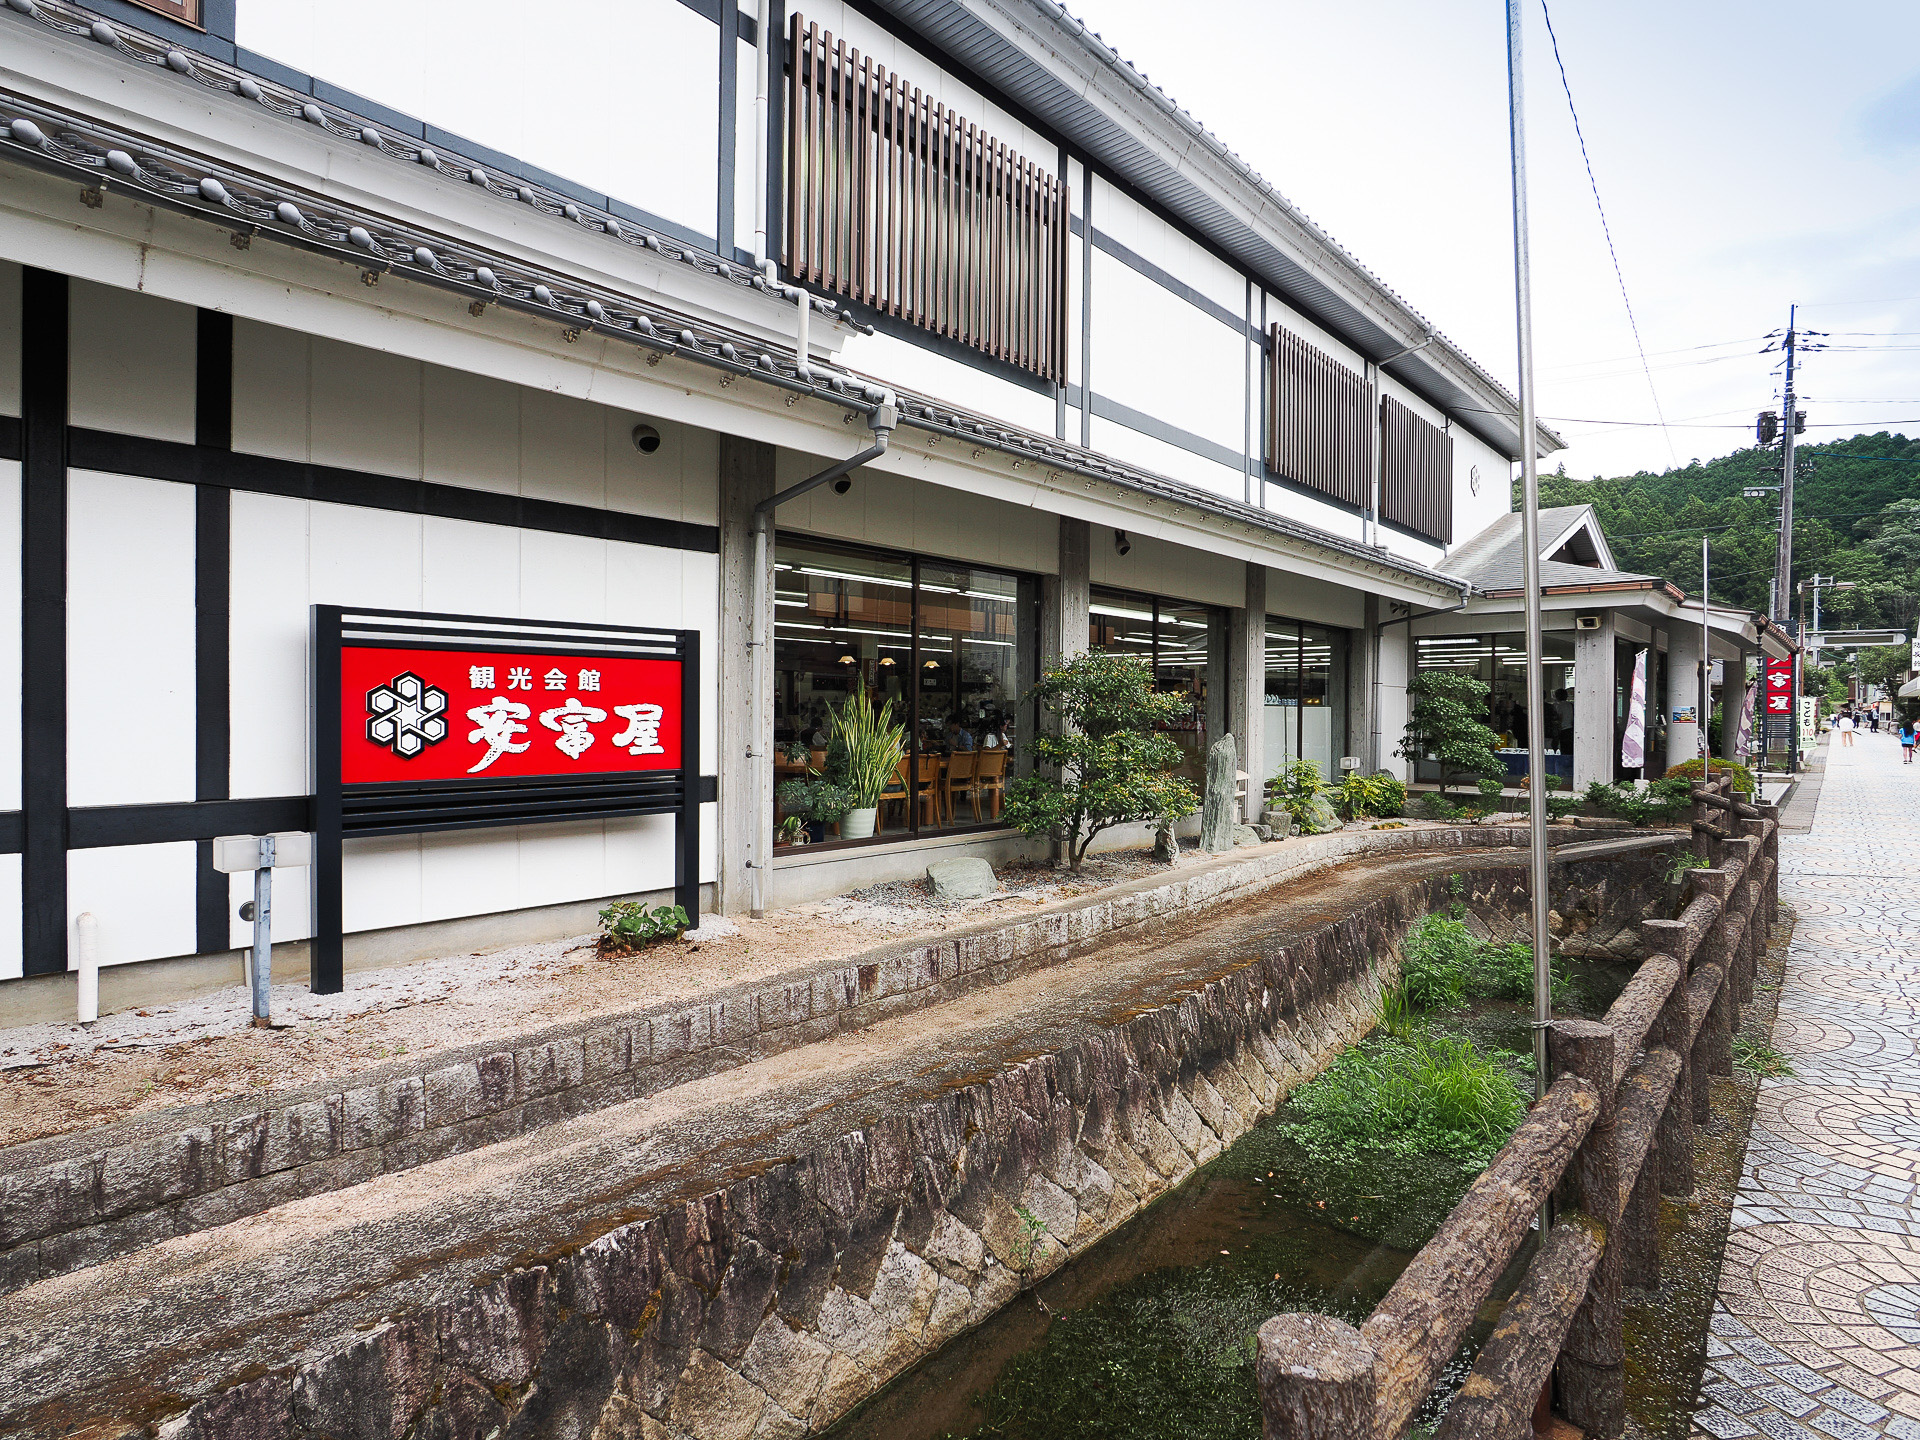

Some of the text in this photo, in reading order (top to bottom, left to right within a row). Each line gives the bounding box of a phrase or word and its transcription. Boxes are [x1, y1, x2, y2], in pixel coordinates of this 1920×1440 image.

[468, 664, 601, 692] 観光会館
[1767, 657, 1791, 711] 富屋
[466, 696, 665, 774] 安富屋
